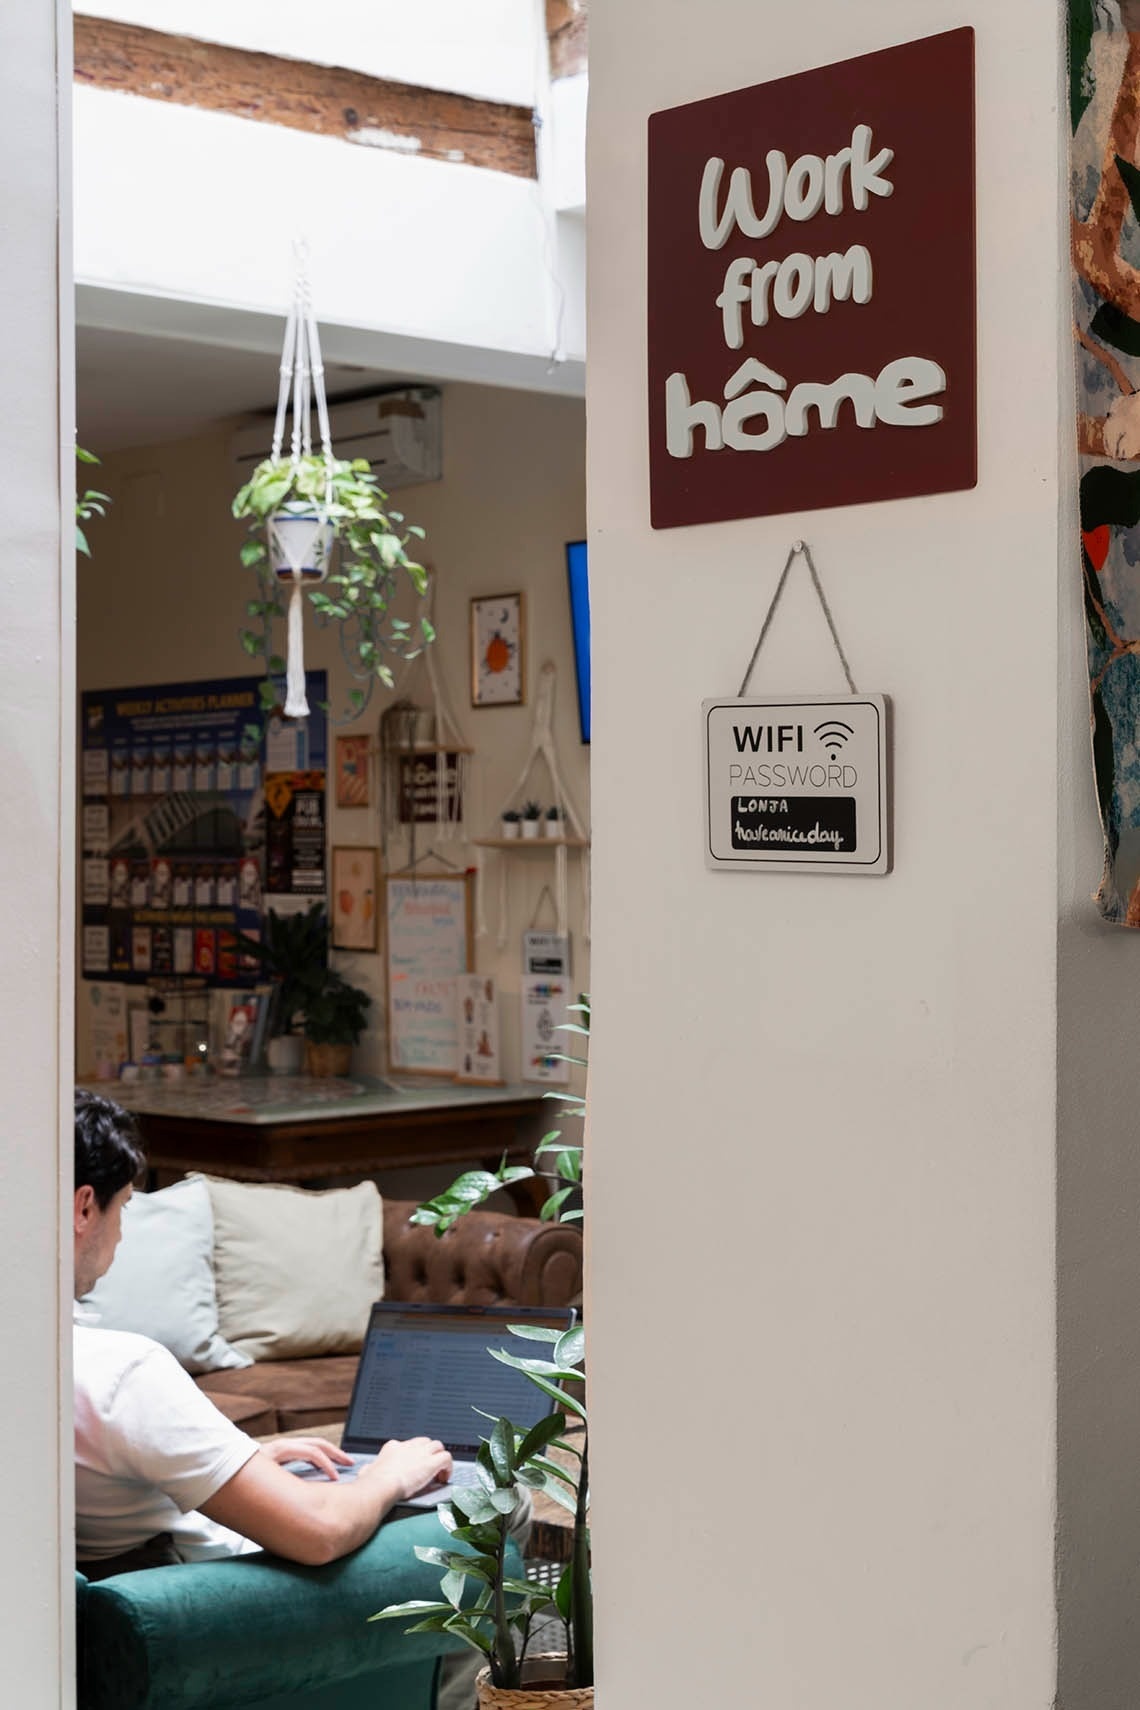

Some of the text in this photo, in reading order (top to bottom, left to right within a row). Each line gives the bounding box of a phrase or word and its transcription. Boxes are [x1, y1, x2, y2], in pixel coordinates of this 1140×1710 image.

[699, 124, 894, 251] Work
[716, 245, 874, 350] from
[665, 356, 946, 459] hôme
[732, 725, 804, 752] WIFI
[729, 764, 858, 788] PASSWORD
[737, 797, 789, 813] LONJA
